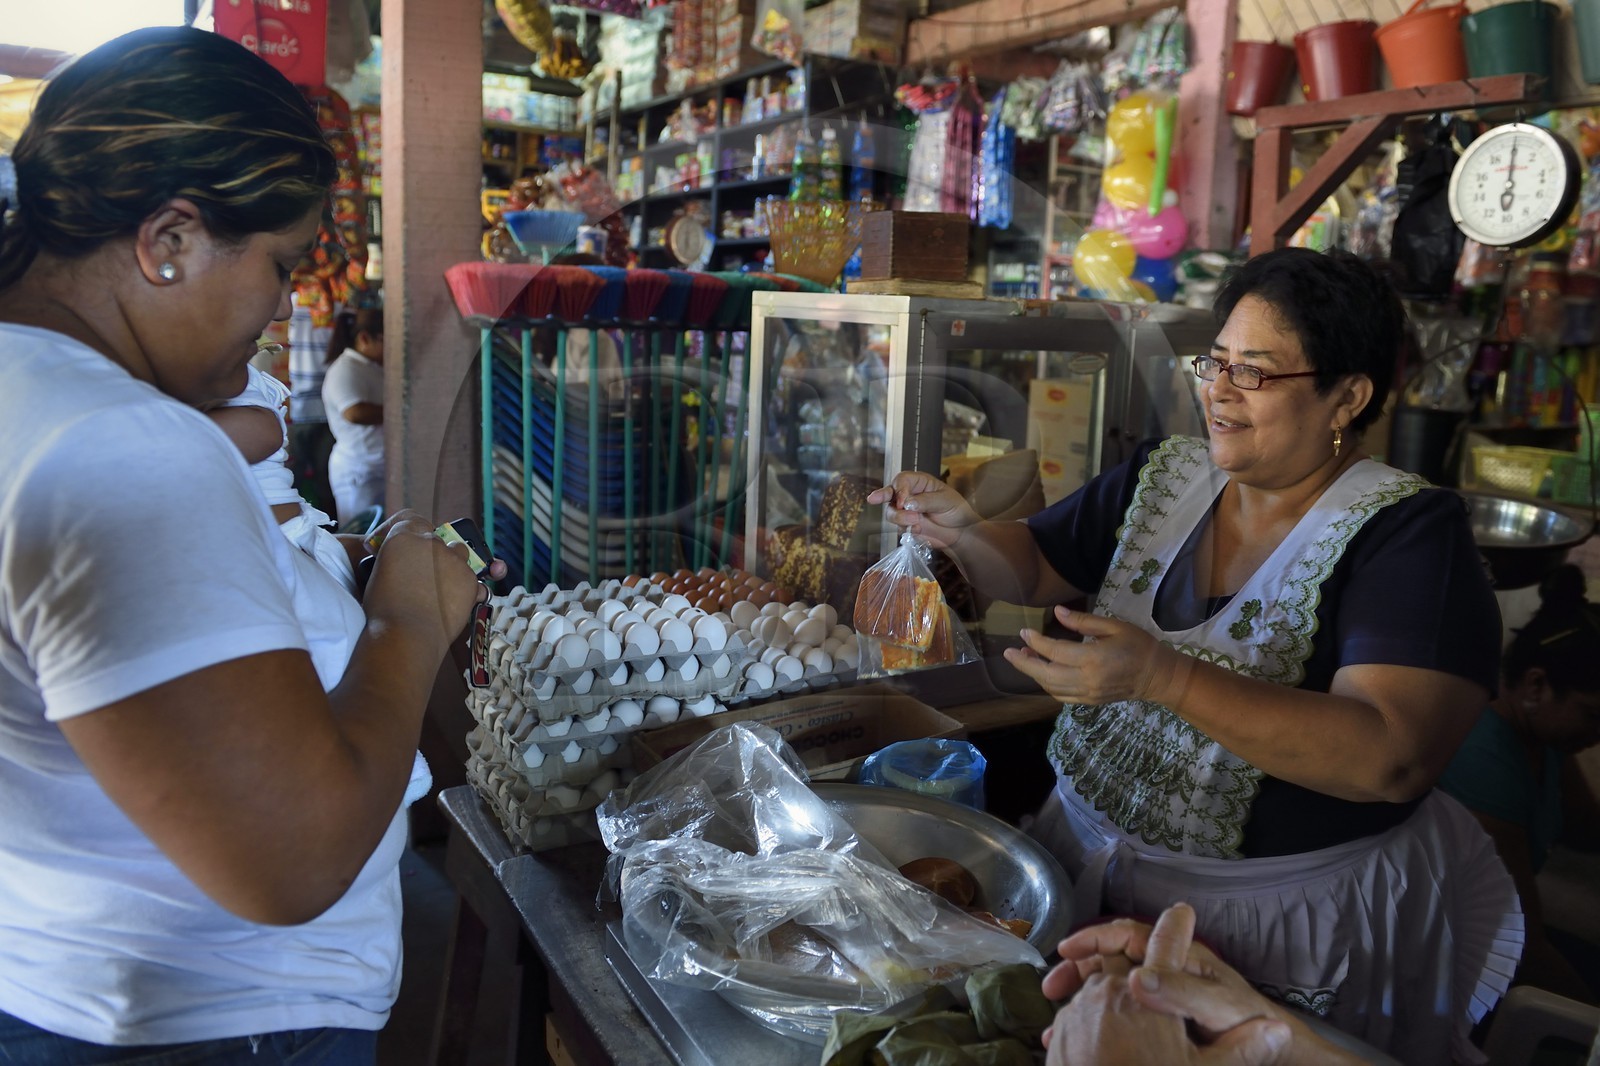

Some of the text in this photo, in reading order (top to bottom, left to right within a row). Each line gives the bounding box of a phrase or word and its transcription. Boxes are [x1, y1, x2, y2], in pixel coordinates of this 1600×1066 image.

[241, 34, 290, 57] Claro
[1529, 152, 1537, 162] 2
[1476, 172, 1488, 182] 16
[1536, 189, 1544, 199] 6
[1501, 213, 1513, 223] 10
